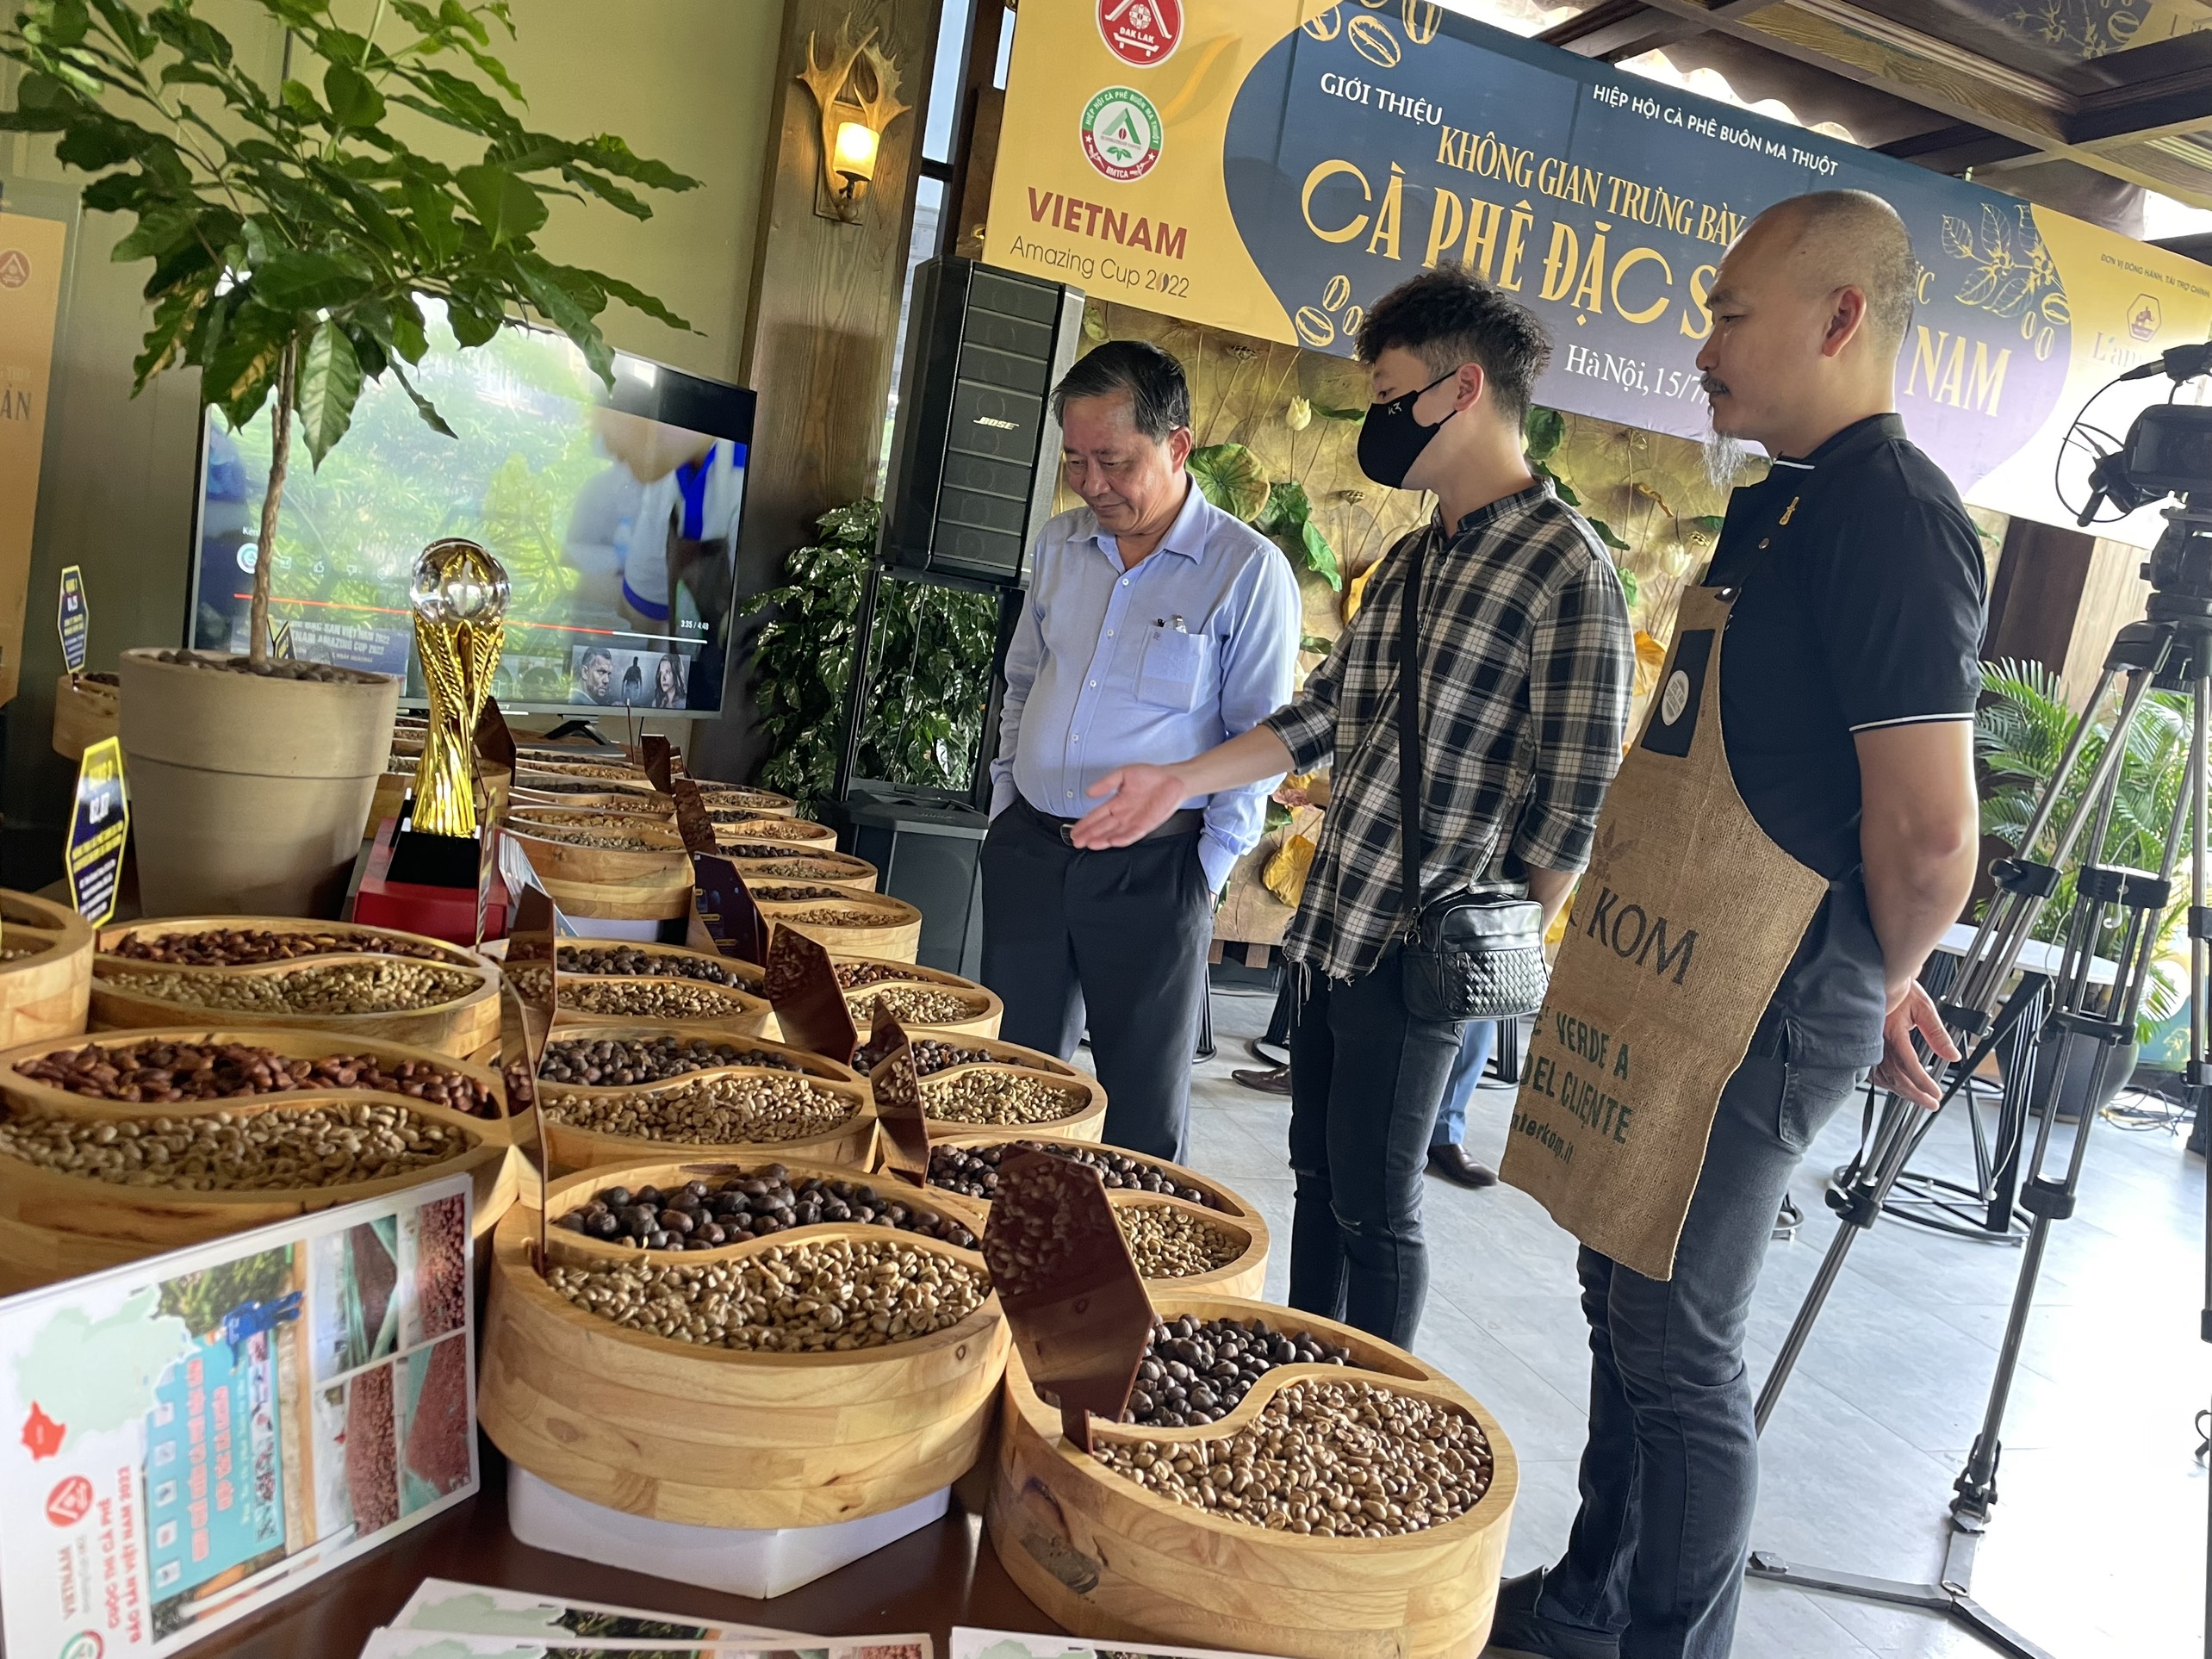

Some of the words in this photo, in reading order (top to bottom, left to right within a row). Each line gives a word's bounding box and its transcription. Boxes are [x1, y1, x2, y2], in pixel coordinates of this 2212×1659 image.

[1320, 72, 1371, 105] GIỚI
[1376, 87, 1443, 126] THIỆU
[1593, 84, 1629, 109] HIỆP
[1631, 97, 1660, 120] HỘI
[1663, 107, 1683, 127] CÀ
[1687, 115, 1716, 138] PHÊ
[1719, 125, 1762, 152] BUÔN
[1765, 140, 1787, 160] MA
[1792, 147, 1838, 176] THUỘT
[1435, 125, 1534, 189] KHÔNG
[1538, 157, 1604, 208] GIAN
[1607, 175, 1694, 235] TRƯNG
[1696, 202, 1747, 246] BÀY
[1028, 186, 1188, 260] VIETNAM
[1301, 158, 1406, 261] CÀ
[1421, 187, 1534, 292] PHÊ
[1538, 221, 1673, 326] ĐẶC
[1010, 235, 1095, 279] Amazing
[1100, 258, 1140, 289] Cup
[1903, 325, 2012, 417] NAM
[972, 416, 1020, 430] BOSE
[1587, 886, 1699, 985] KOM
[1556, 1010, 1610, 1070] VERDE
[1613, 1042, 1629, 1080] A
[1561, 1071, 1634, 1145] CLIENTE
